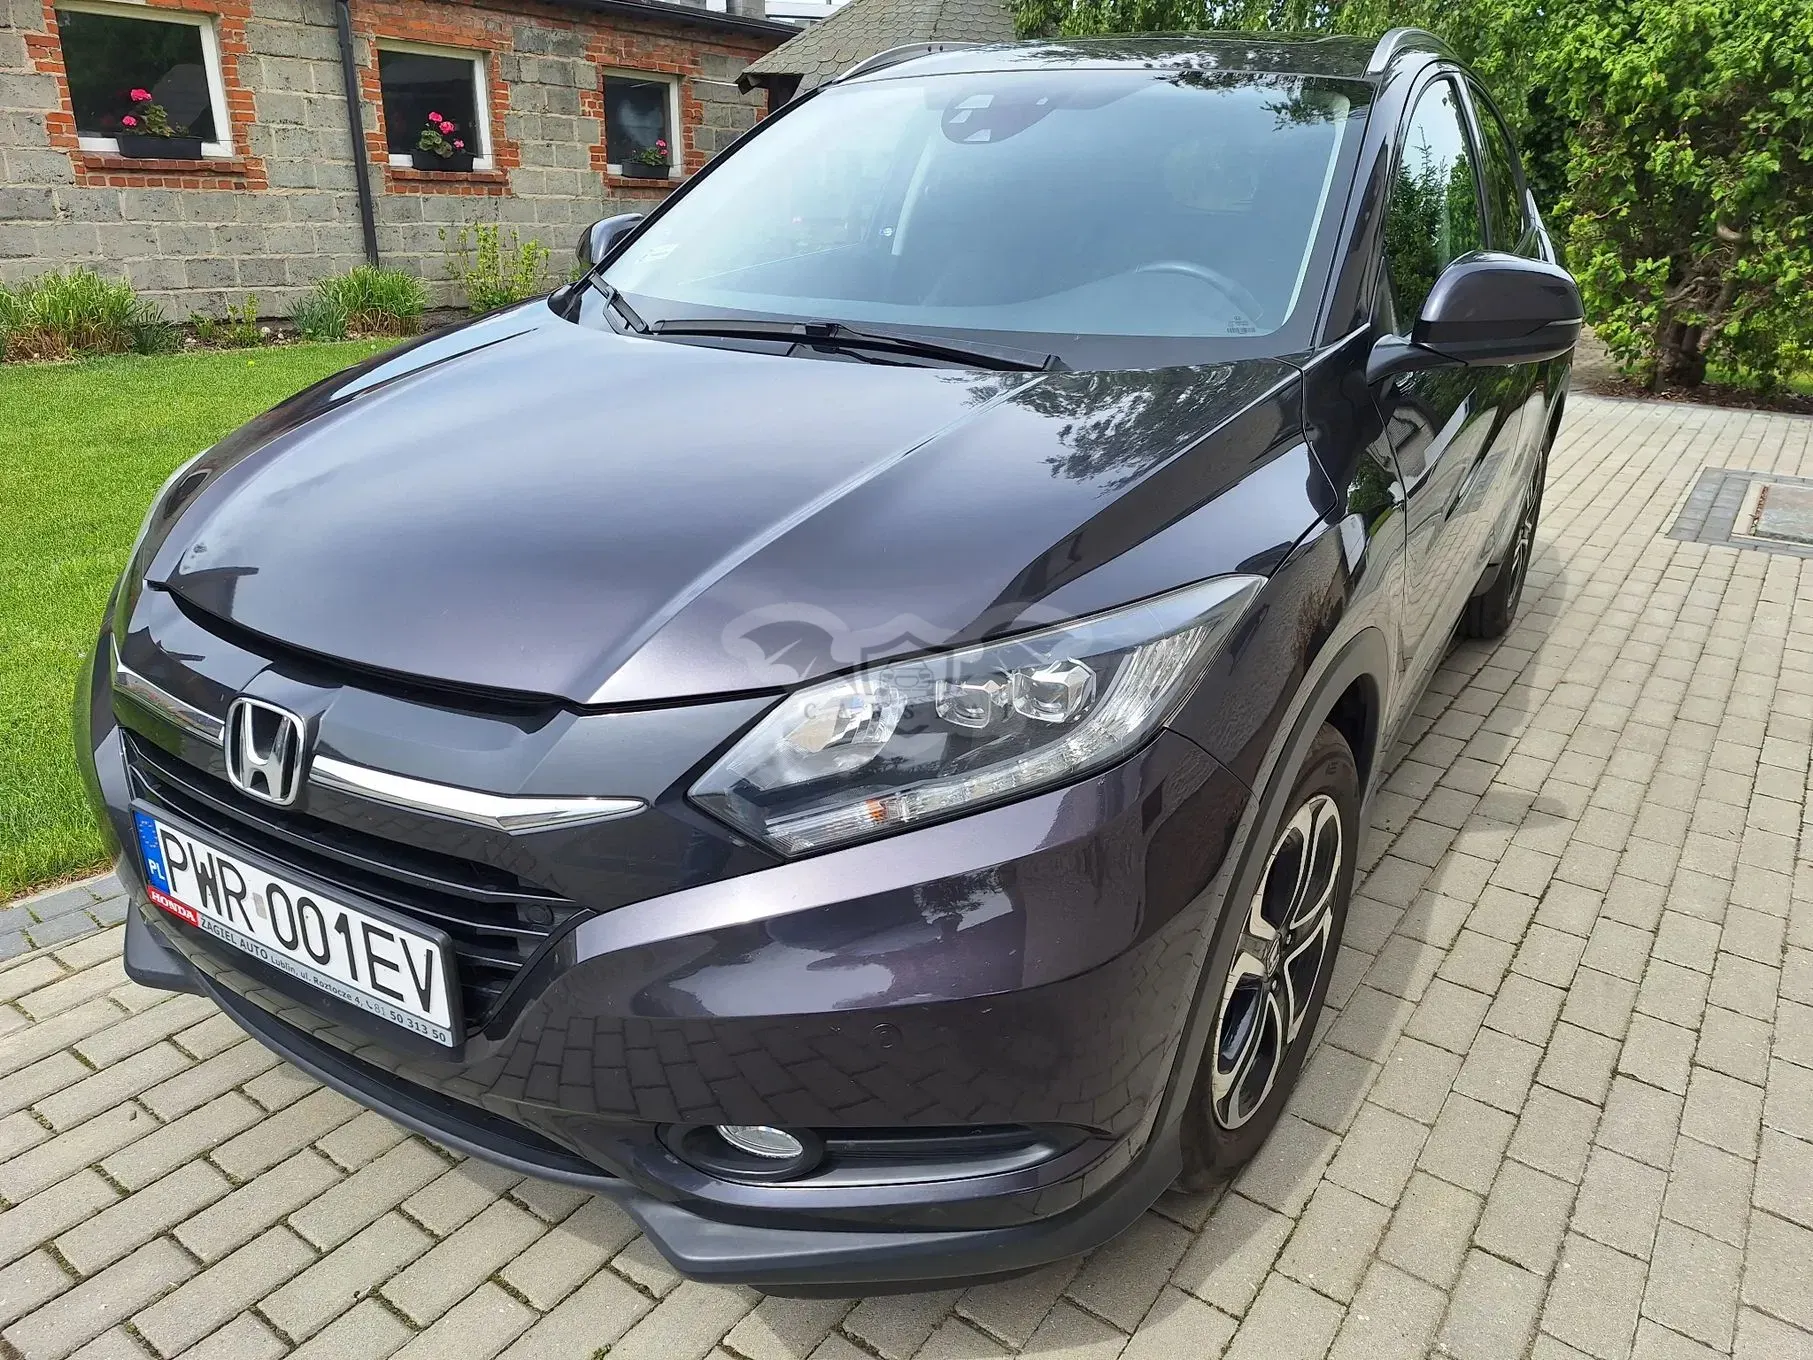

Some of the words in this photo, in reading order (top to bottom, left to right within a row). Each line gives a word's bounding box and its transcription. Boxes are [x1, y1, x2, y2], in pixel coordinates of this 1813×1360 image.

[148, 858, 166, 881] PL
[150, 891, 197, 922] HONDA
[160, 828, 255, 934] PWR
[265, 882, 434, 1013] 001EV
[239, 939, 268, 960] AUTO
[389, 1010, 404, 1024] 50
[407, 1019, 429, 1035] 313
[432, 1029, 446, 1043] 50
